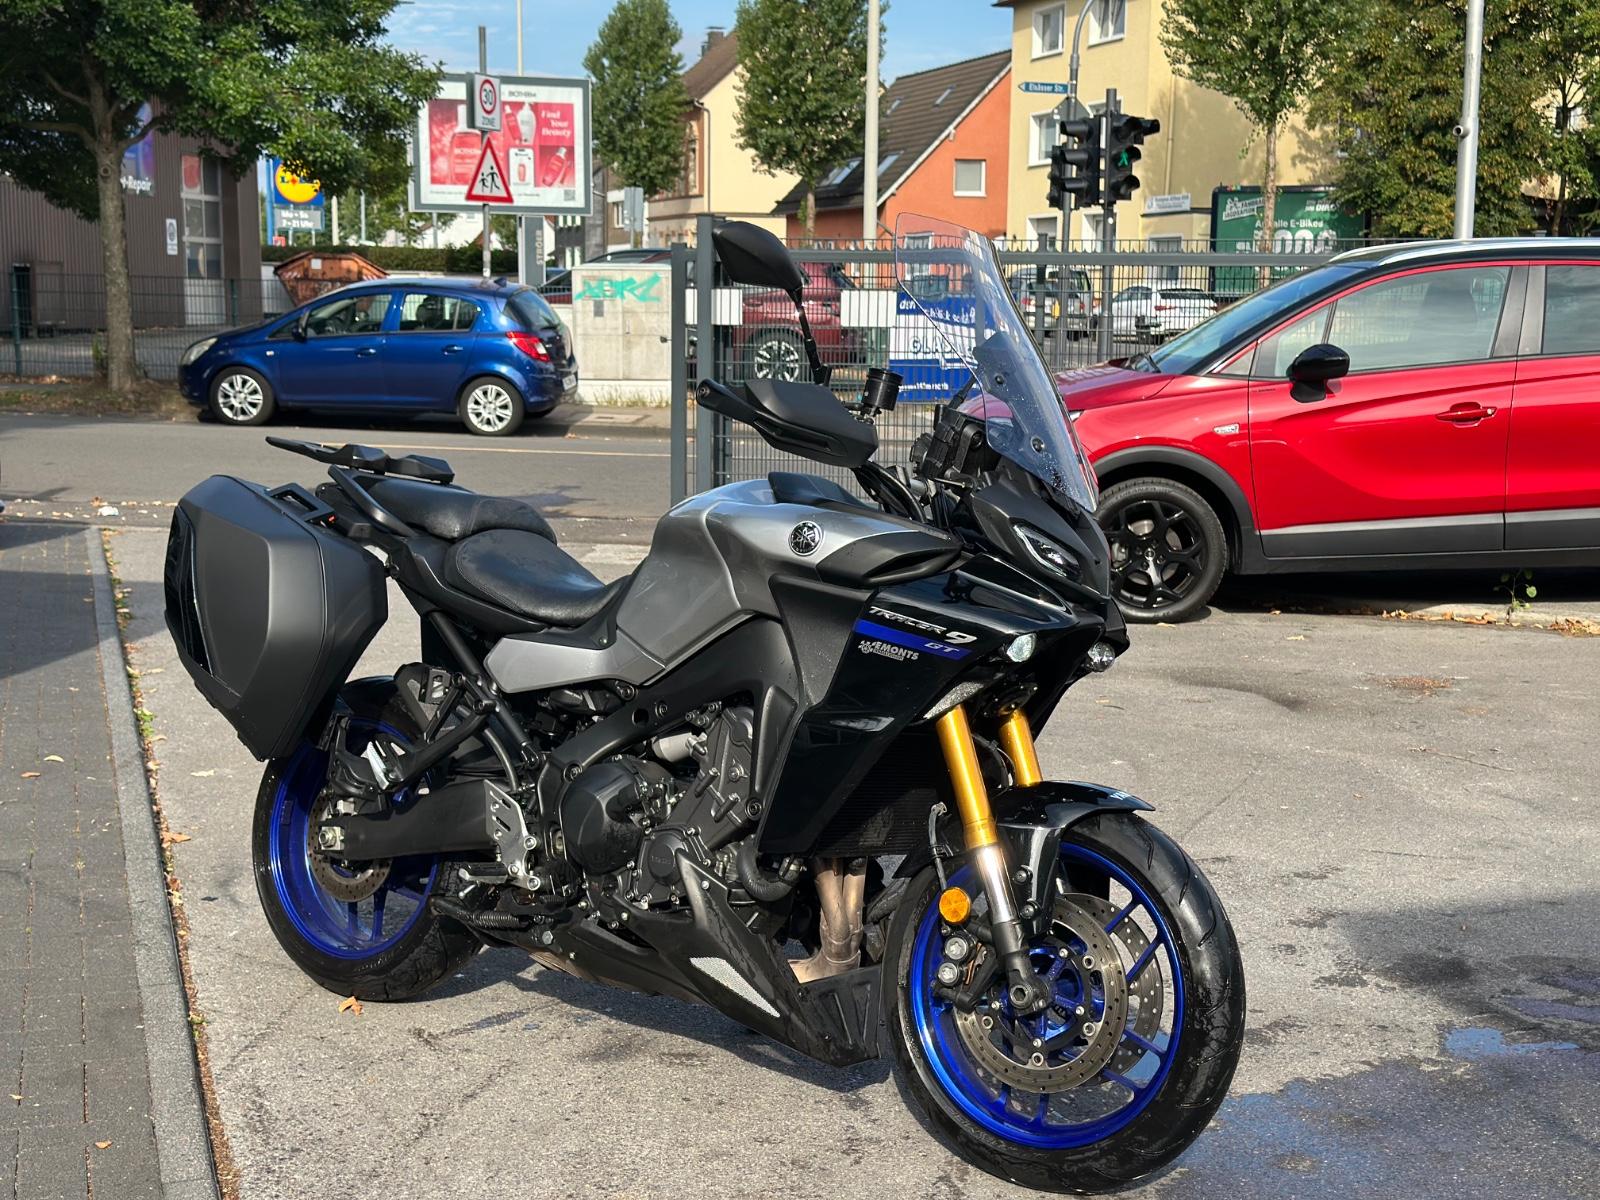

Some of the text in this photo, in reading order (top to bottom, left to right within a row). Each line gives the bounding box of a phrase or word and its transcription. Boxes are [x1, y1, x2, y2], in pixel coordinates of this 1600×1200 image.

[483, 88, 493, 105] 30
[541, 110, 561, 119] Find
[482, 116, 496, 127] ZONE
[550, 119, 569, 128] Your
[541, 127, 571, 138] Beauty
[1290, 219, 1324, 228] E-Bikes
[868, 606, 978, 644] TRACER 9
[924, 642, 960, 653] GT
